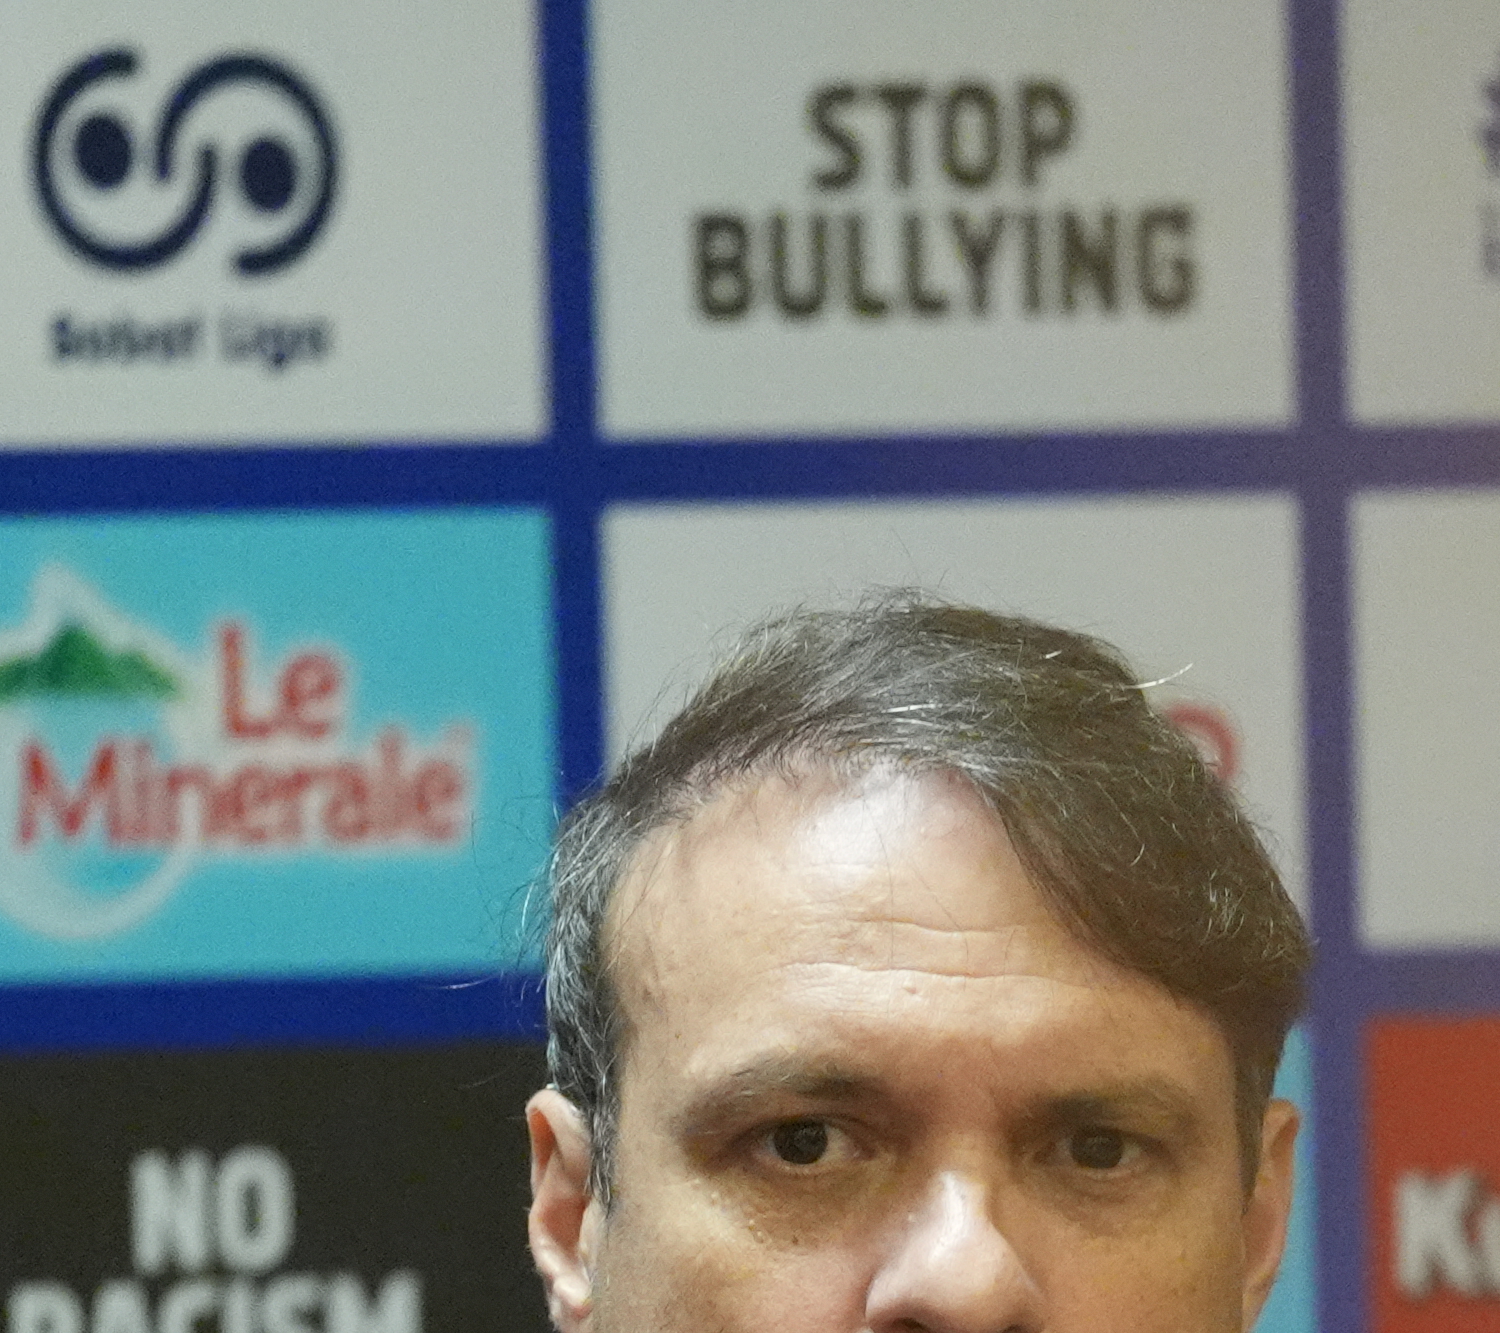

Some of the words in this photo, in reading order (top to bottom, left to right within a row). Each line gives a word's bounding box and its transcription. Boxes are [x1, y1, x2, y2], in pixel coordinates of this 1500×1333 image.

[806, 78, 1078, 193] STOP
[692, 204, 1197, 323] BULLYING
[216, 615, 342, 740] Le
[132, 1148, 294, 1275] NO
